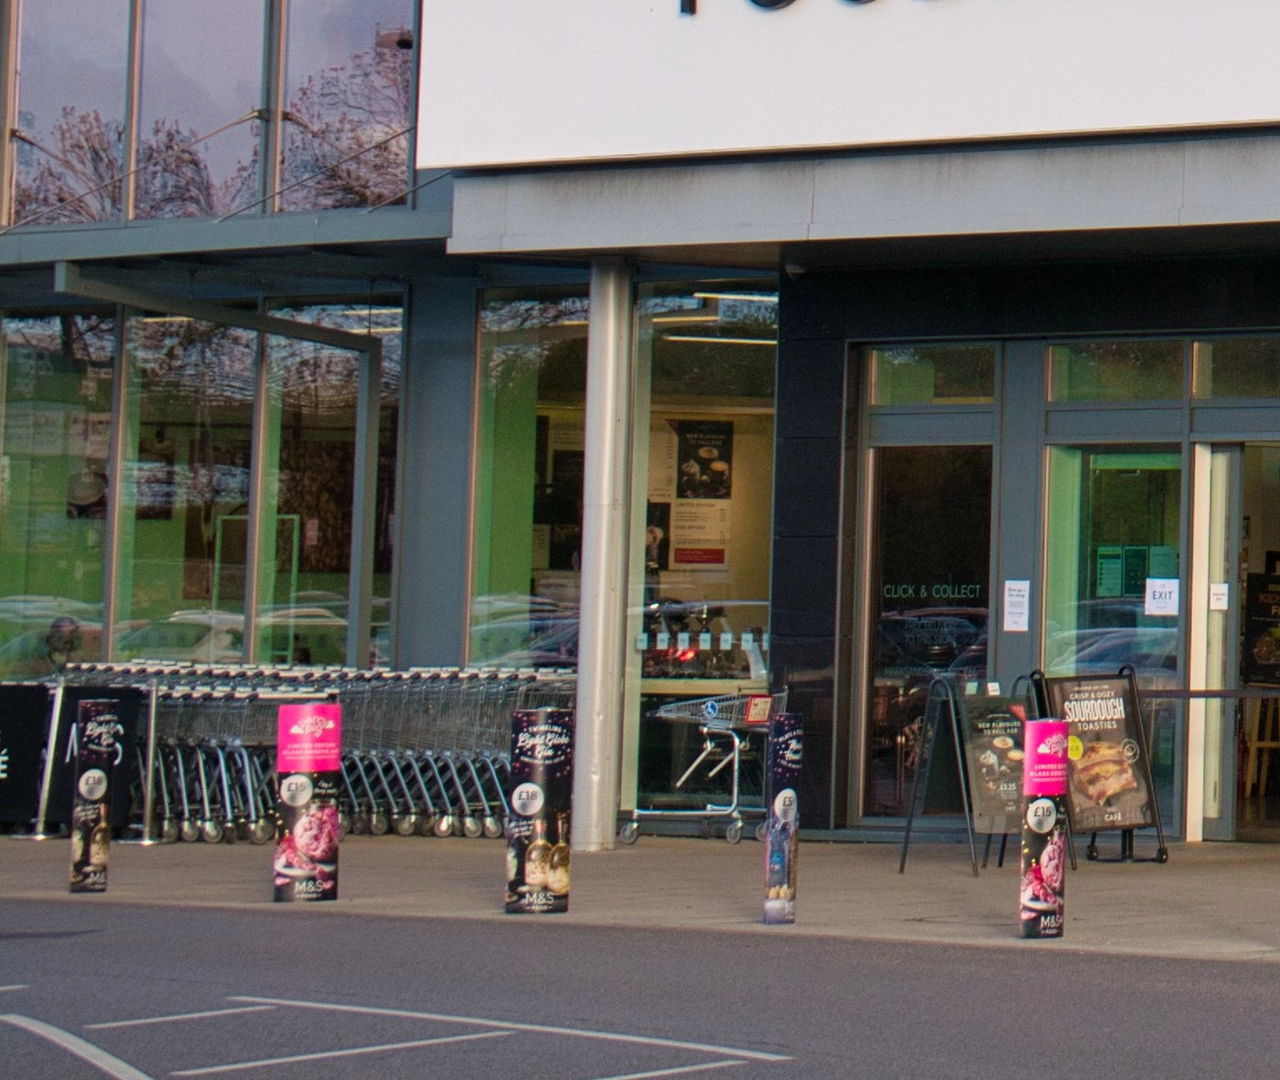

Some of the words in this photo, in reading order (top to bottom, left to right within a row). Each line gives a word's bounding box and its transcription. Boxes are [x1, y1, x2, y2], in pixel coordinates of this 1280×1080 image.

[883, 584, 915, 598] CLICK
[920, 584, 928, 598] &
[932, 584, 981, 598] COLLECT
[1152, 590, 1173, 600] EXIT
[1064, 697, 1125, 722] SOURDOUGH
[1077, 721, 1117, 731] TOASTIES
[287, 781, 306, 792] £15
[517, 790, 538, 801] £18
[782, 796, 793, 807] £5
[1033, 806, 1052, 817] £15
[294, 880, 323, 892] M&S
[525, 891, 554, 904] M&S
